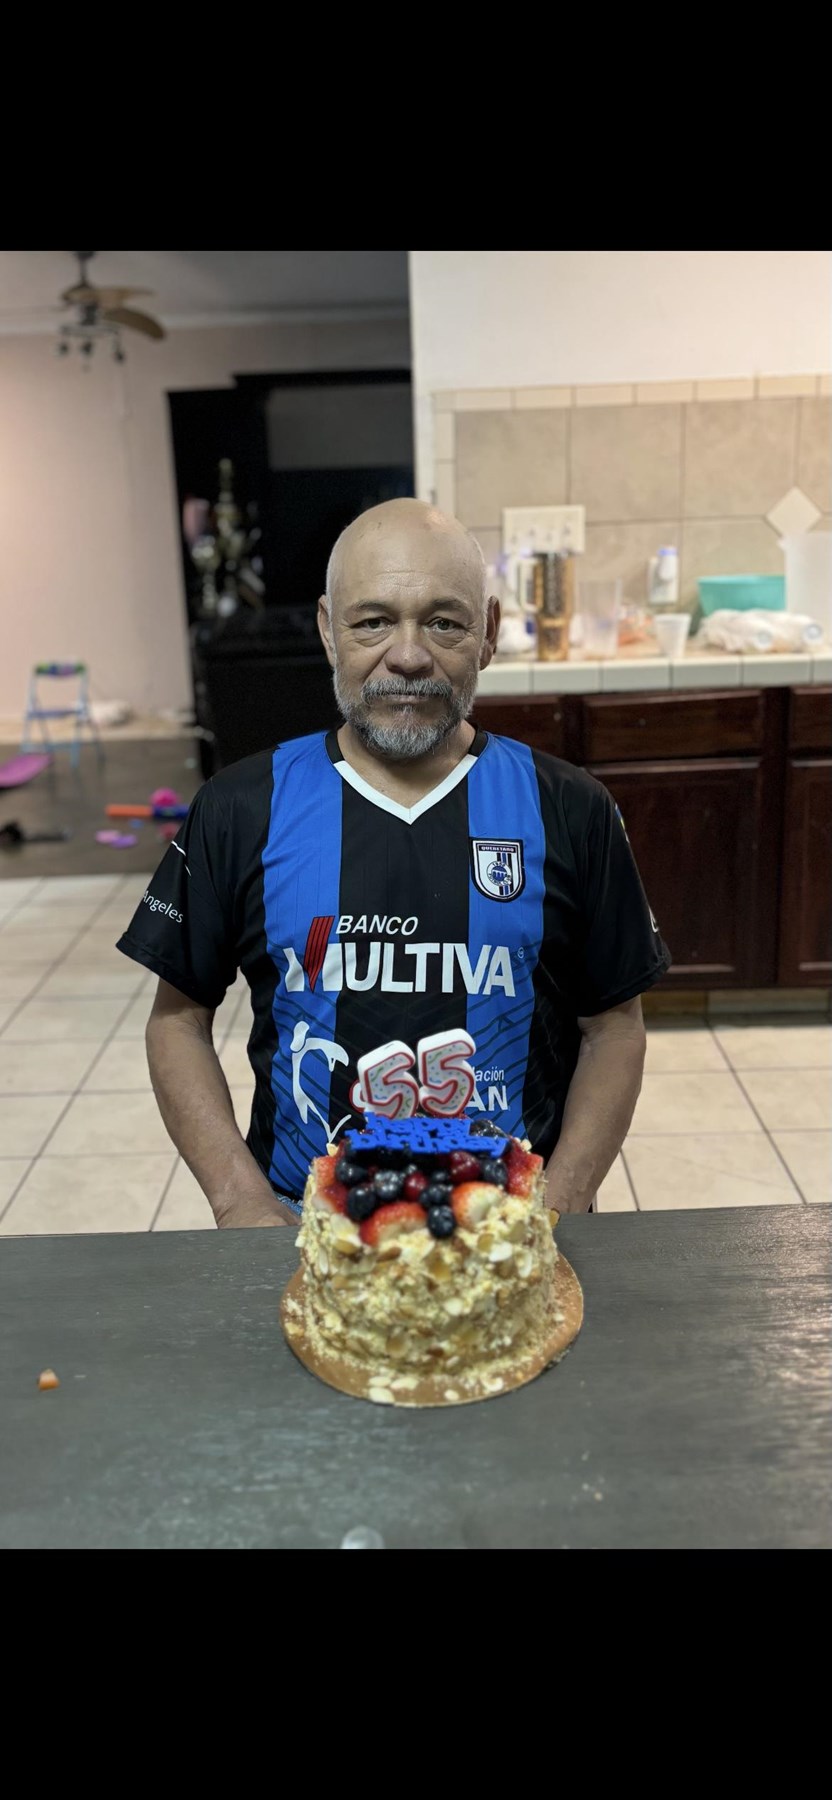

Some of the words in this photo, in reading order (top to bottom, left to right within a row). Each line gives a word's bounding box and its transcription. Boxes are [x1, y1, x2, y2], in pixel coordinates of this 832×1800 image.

[336, 915, 419, 936] BANCO
[283, 942, 516, 996] MULTIVA
[357, 1028, 477, 1119] 55
[473, 1066, 505, 1081] ación
